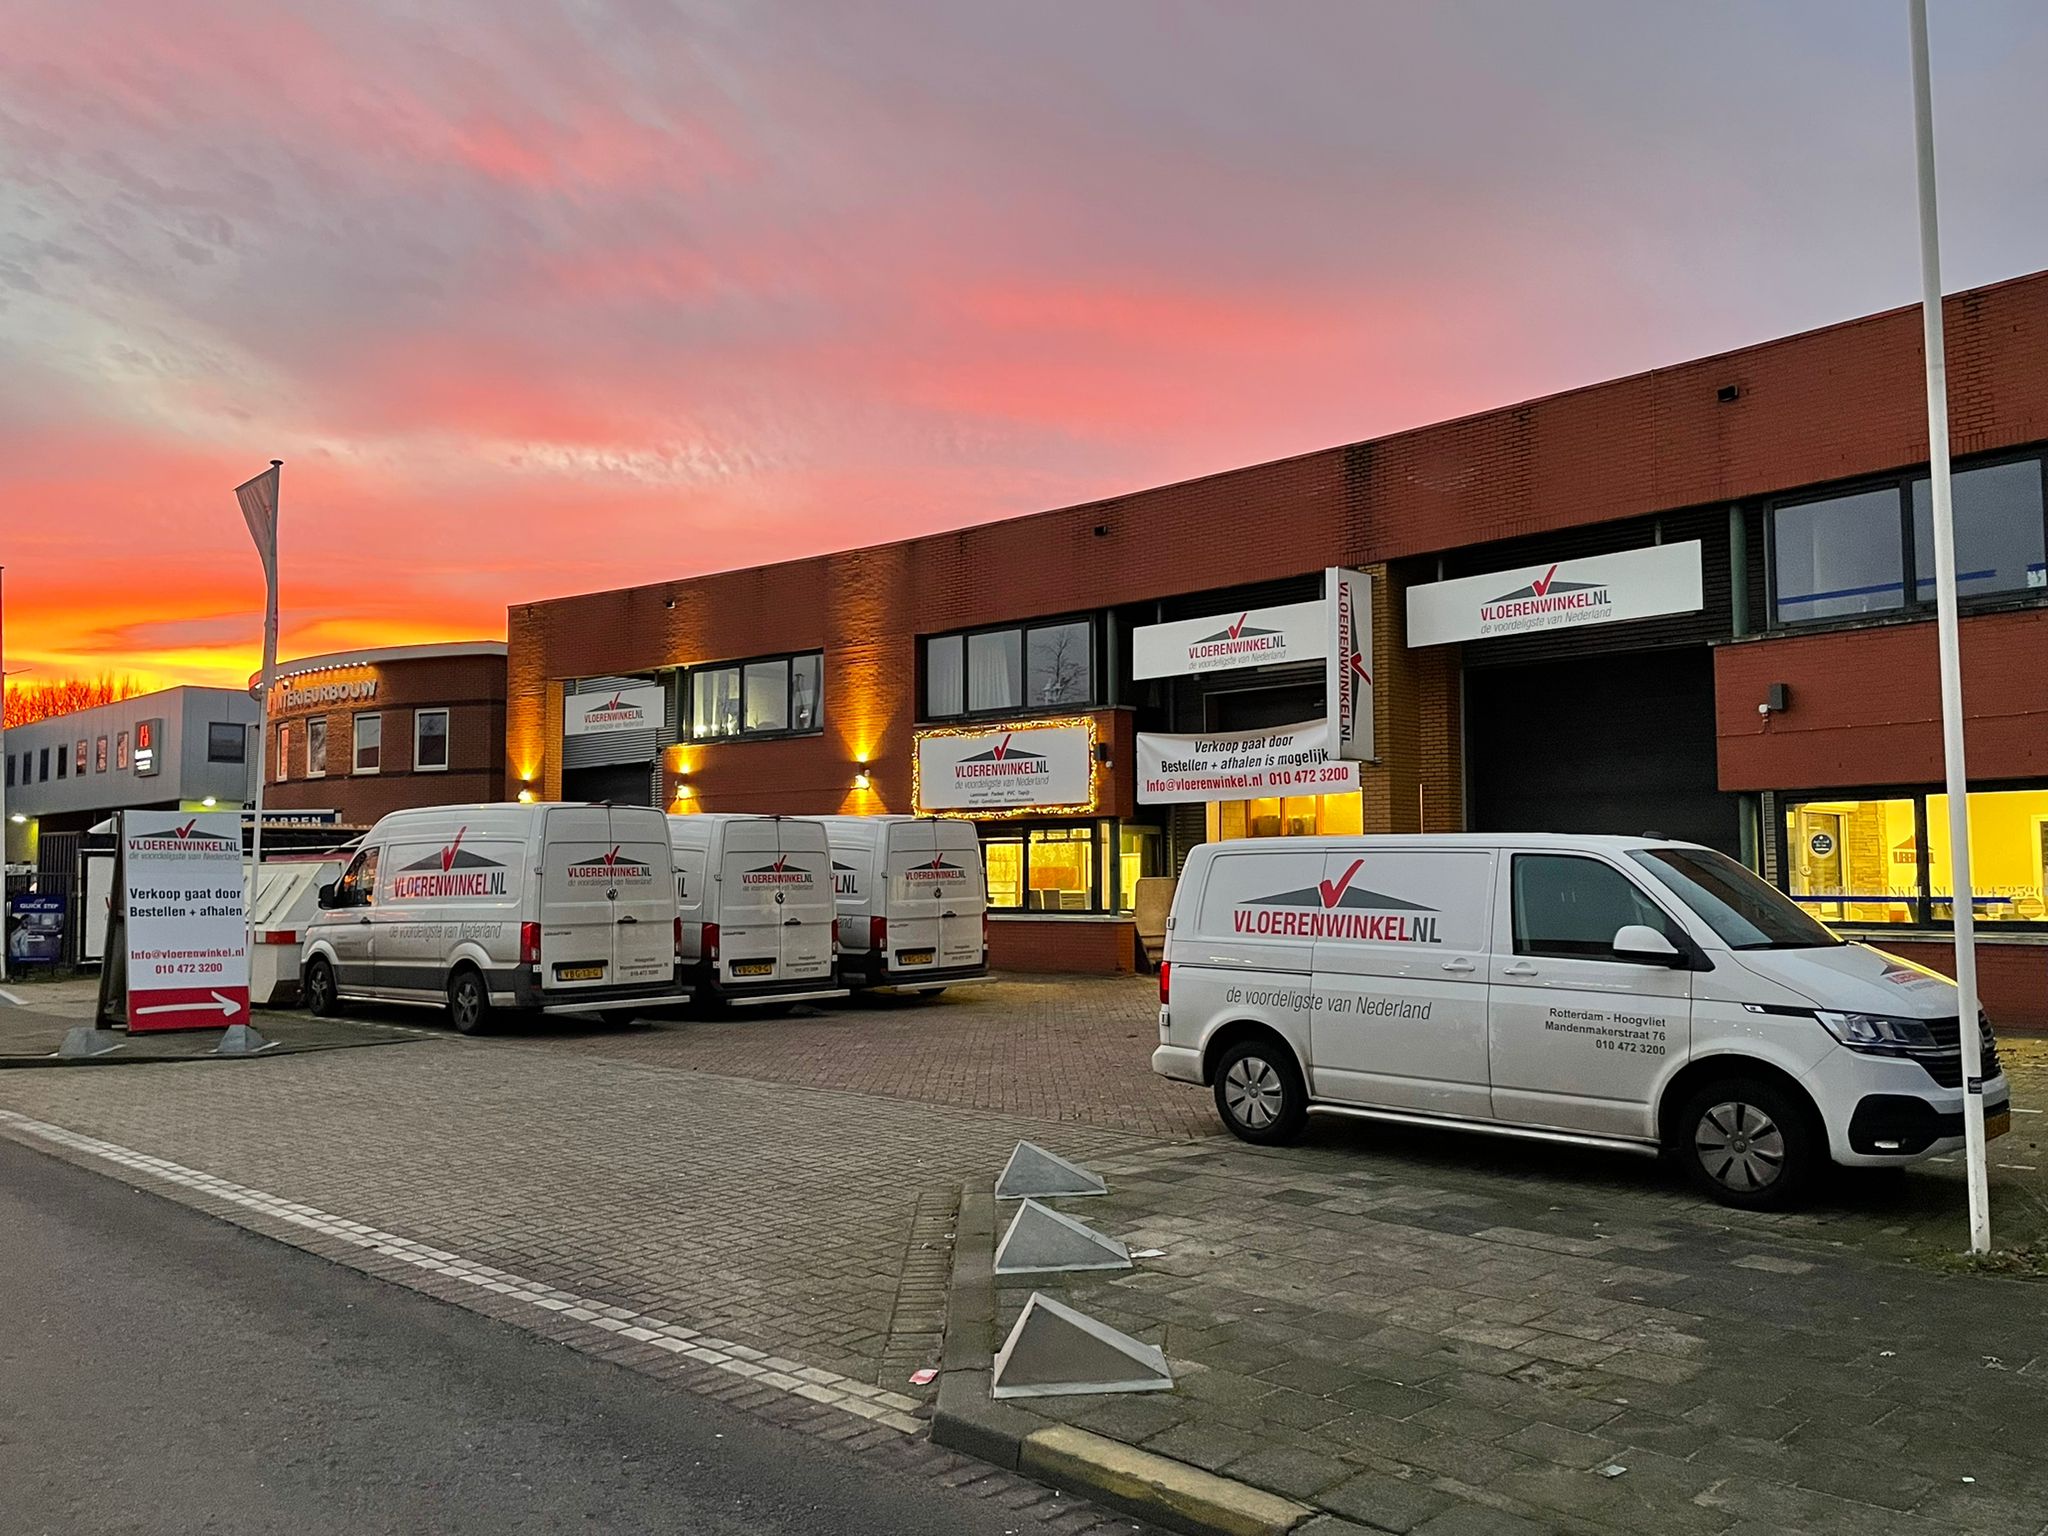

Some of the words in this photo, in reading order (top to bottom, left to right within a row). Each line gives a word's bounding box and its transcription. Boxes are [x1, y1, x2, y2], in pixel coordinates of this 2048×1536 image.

[1480, 624, 1492, 635] de
[1494, 616, 1545, 632] voordeligste
[1547, 613, 1563, 625] van
[1565, 607, 1612, 623] Nederland
[1188, 661, 1196, 670] de
[1238, 656, 1250, 664] van
[1252, 650, 1287, 661] Nederland
[1194, 740, 1239, 754] Verkoop
[1241, 738, 1266, 753] gaat
[1269, 735, 1294, 748] door
[1161, 759, 1208, 773] Bestellen
[1220, 755, 1262, 770] afhalen
[1264, 753, 1275, 766] is
[1277, 749, 1329, 767] mogelijk
[954, 780, 963, 790] de
[964, 778, 1001, 790] voordeligste
[1003, 779, 1015, 788] van
[1016, 775, 1050, 786] Nederland
[1146, 773, 1263, 793] Info@vloerenwinkel.nl
[1269, 771, 1291, 786] 010
[1294, 769, 1316, 784] 472
[1319, 767, 1349, 782] 3200
[129, 888, 181, 901] Verkoop
[184, 888, 212, 901] gaat
[215, 888, 241, 899] door
[129, 906, 186, 917] Bestellen
[189, 909, 197, 917] +
[200, 905, 243, 917] afhalen
[443, 925, 458, 938] van
[460, 922, 502, 939] Nederland
[1233, 910, 1442, 943] VLOERENWINKEL.NL
[131, 947, 244, 960] Info@vloerenwinkel.nl
[155, 964, 174, 975] 010
[177, 963, 196, 973] 472
[198, 962, 223, 973] 3200
[1226, 986, 1241, 1003] de
[1245, 989, 1323, 1013] voordeligste
[1327, 997, 1351, 1013] van
[1356, 996, 1432, 1020] Nederland
[1549, 1007, 1604, 1021] Rotterdam
[1613, 1013, 1666, 1028] Hoogvliet
[1545, 1021, 1650, 1040] Mandenmakerstraat
[1652, 1031, 1666, 1041] 76
[1595, 1039, 1615, 1050] 010
[1617, 1042, 1637, 1053] 472
[1640, 1044, 1666, 1055] 3200
